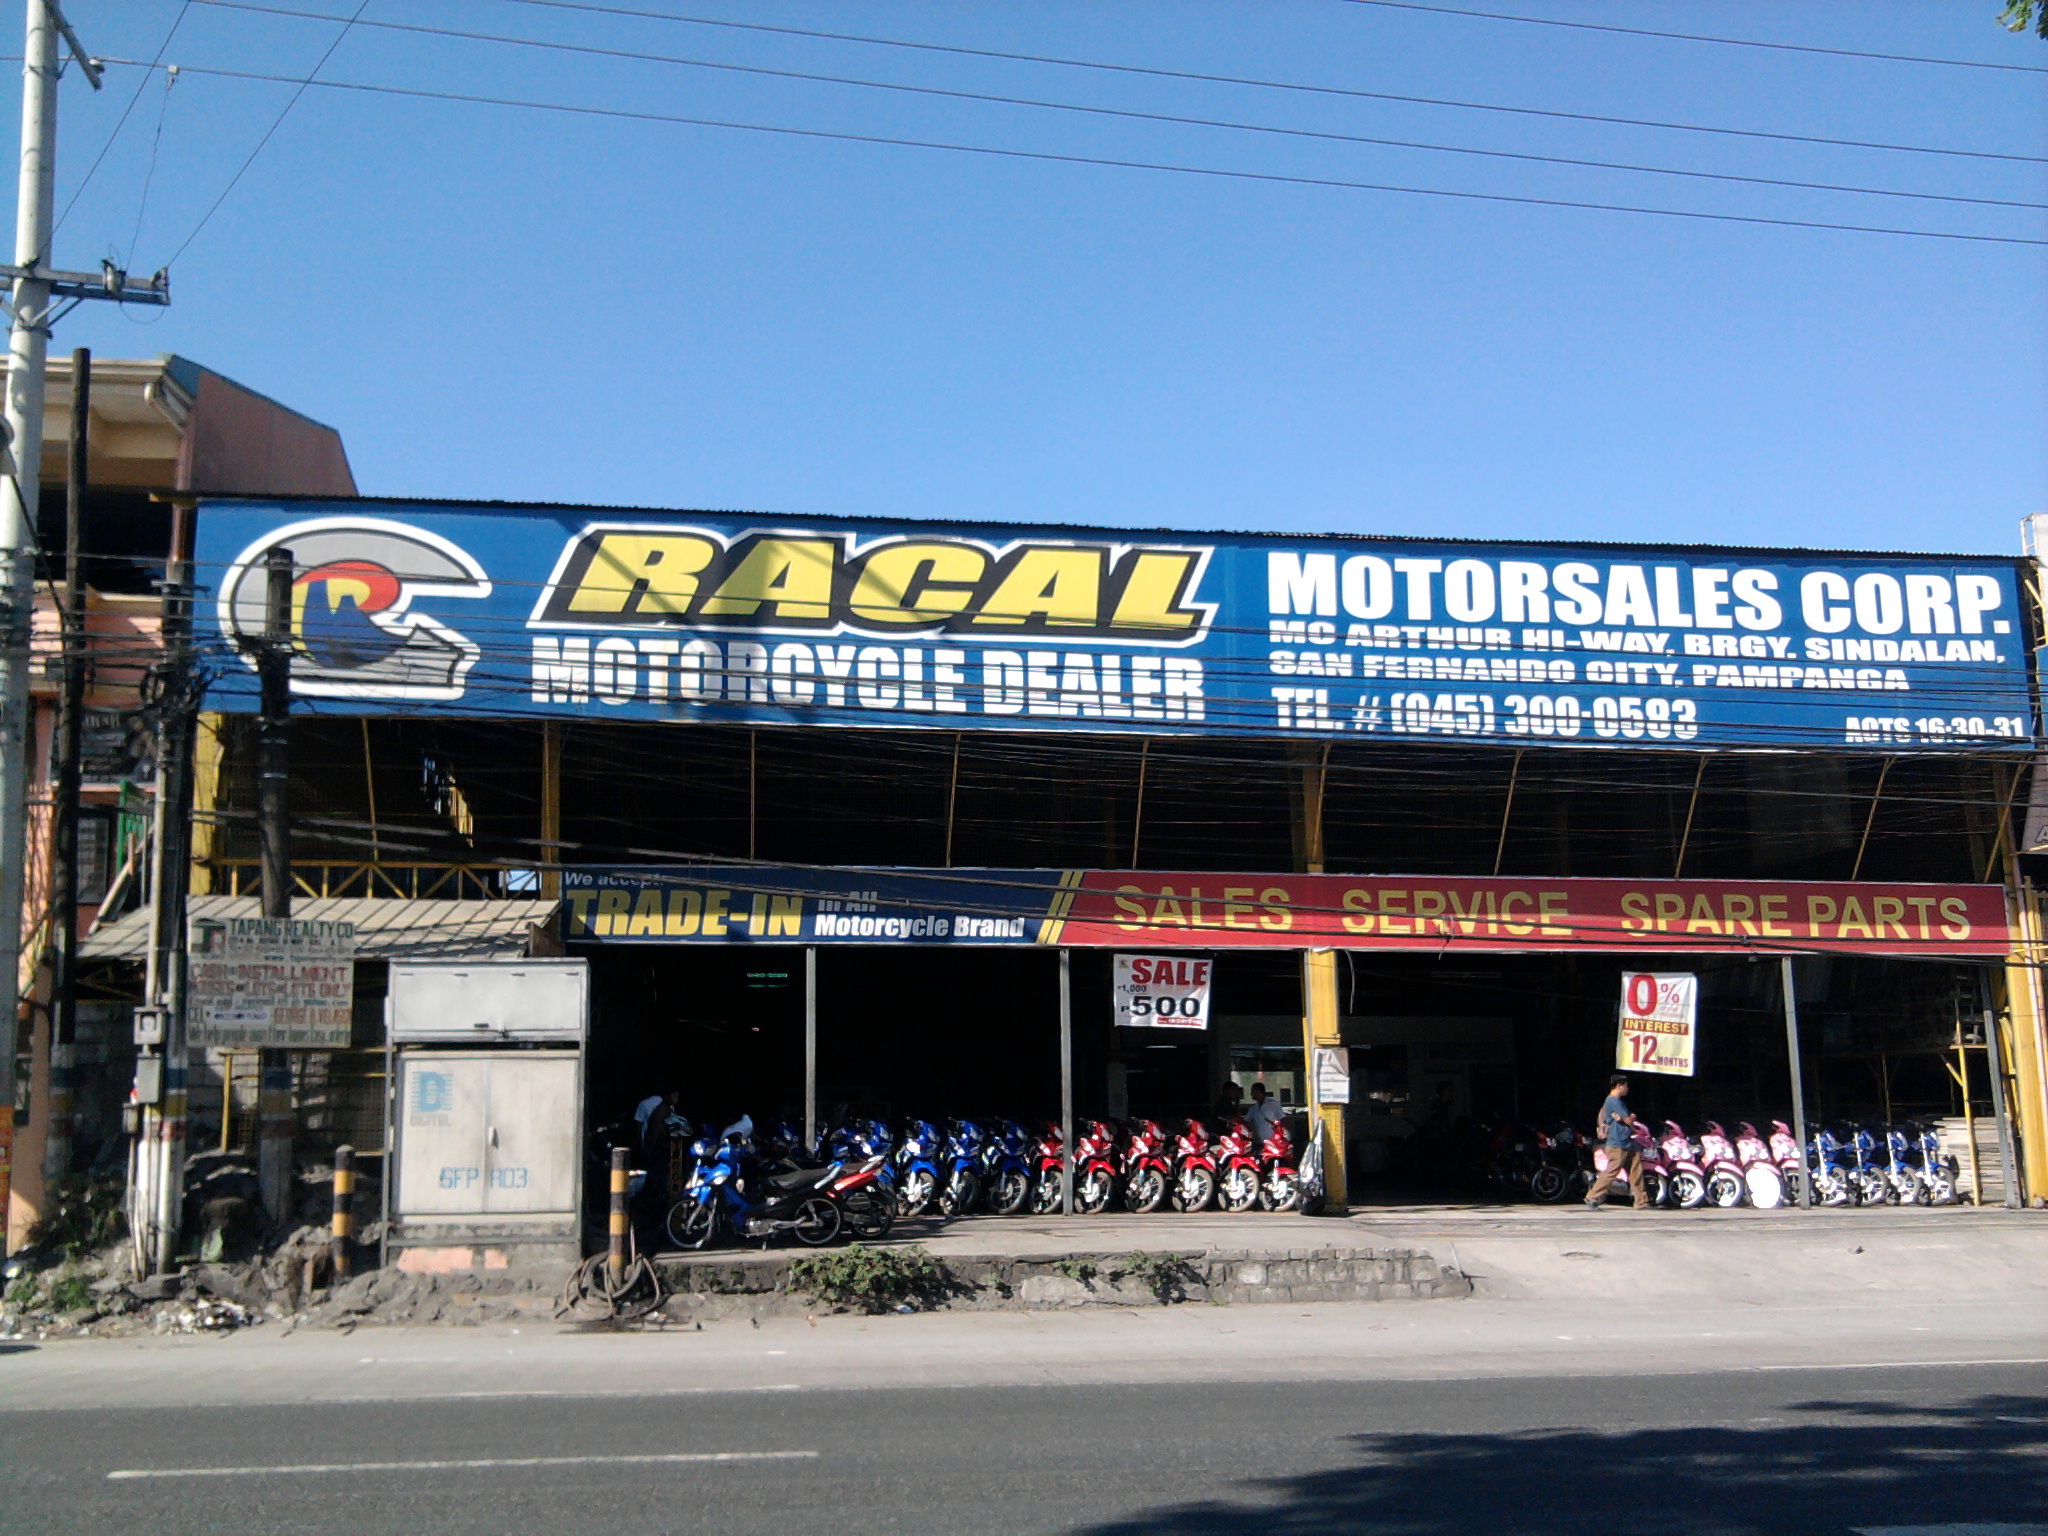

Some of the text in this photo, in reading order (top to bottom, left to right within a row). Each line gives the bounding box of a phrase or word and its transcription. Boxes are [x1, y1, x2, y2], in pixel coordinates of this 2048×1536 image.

[566, 533, 1200, 631] RACAL
[1267, 551, 2011, 635] MOTORSALES CORP.
[1269, 620, 1336, 645] MC
[1345, 624, 1512, 650] ARTHUR
[1684, 634, 1797, 659] BRGY.
[1805, 637, 2005, 663] SINDALAN,
[531, 637, 1206, 721] MOTORCYCLE DEALER
[1269, 650, 1353, 677] SAN
[1364, 655, 1576, 683] FERNANDO
[1692, 665, 1910, 690] PAMPANGA
[1271, 687, 1699, 741] TEL. # (045) 300-0593
[1845, 716, 1912, 743] ACTS
[230, 918, 283, 936] TAPANG
[285, 920, 334, 937] REALTY
[565, 890, 803, 937] TRADE-IN
[814, 914, 1026, 939] Motorcycle Brand
[1113, 884, 1971, 940] SALES SERVICE SPARE PARTS
[1131, 958, 1209, 986] SALE
[1625, 1018, 1688, 1034] INTEREST
[1629, 1034, 1657, 1065] 12
